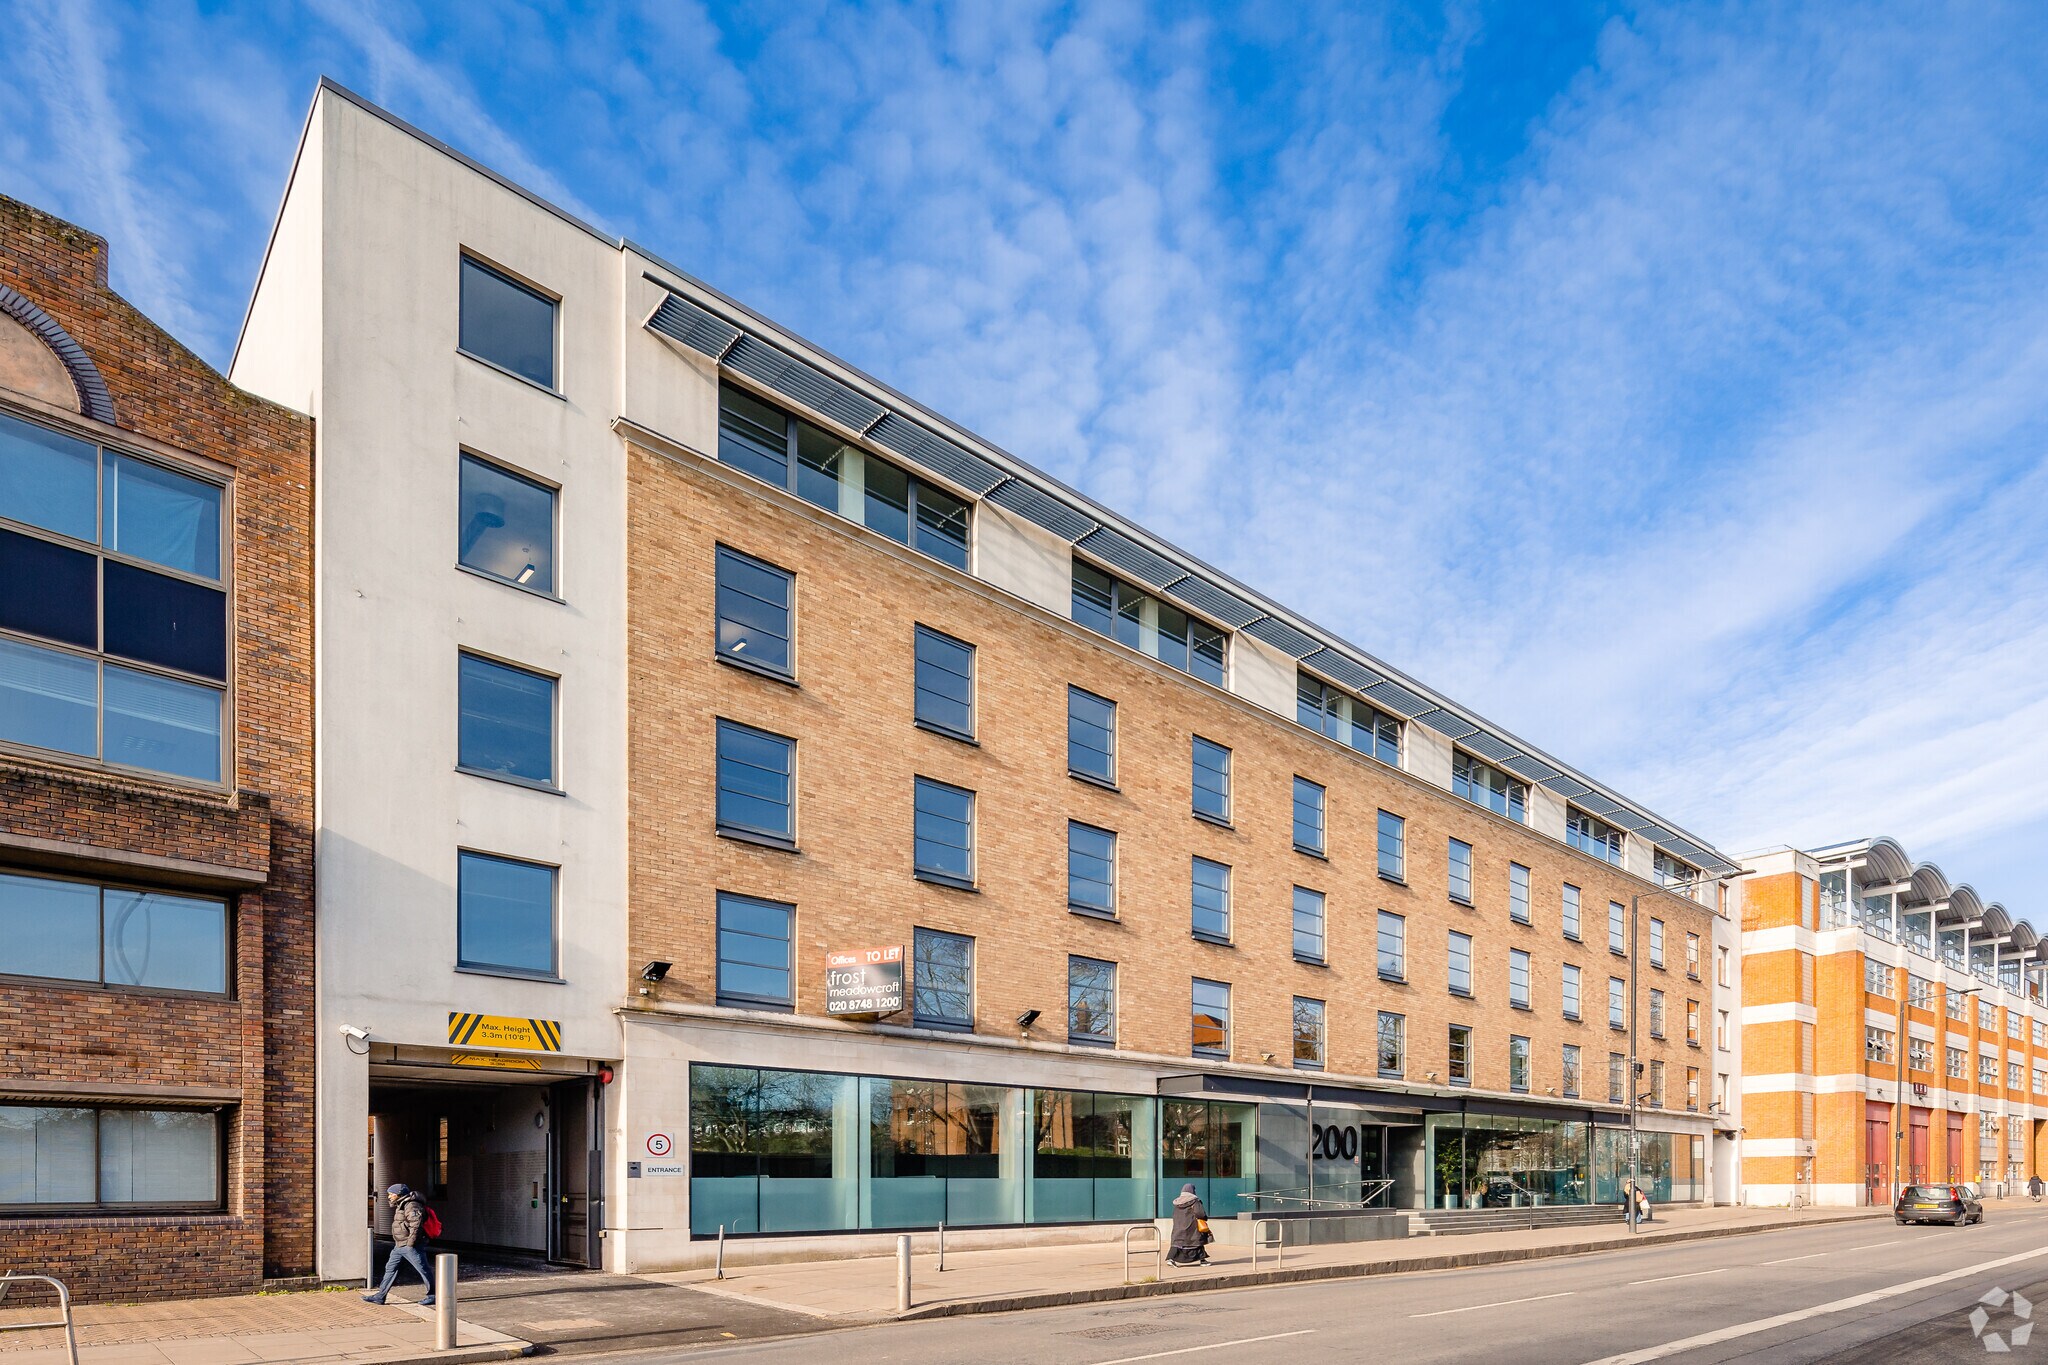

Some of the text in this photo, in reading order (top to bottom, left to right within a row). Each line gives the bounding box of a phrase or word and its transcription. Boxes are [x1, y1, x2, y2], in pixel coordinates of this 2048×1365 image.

[831, 947, 900, 965] Offices TO LET
[830, 968, 867, 986] frost
[829, 981, 900, 997] meadowcroft
[829, 996, 899, 1011] 020 8748 1200
[481, 1023, 531, 1034] Max. Height
[481, 1031, 503, 1039] 3.3m
[655, 1140, 664, 1150] 5
[1306, 1123, 1358, 1160] 200
